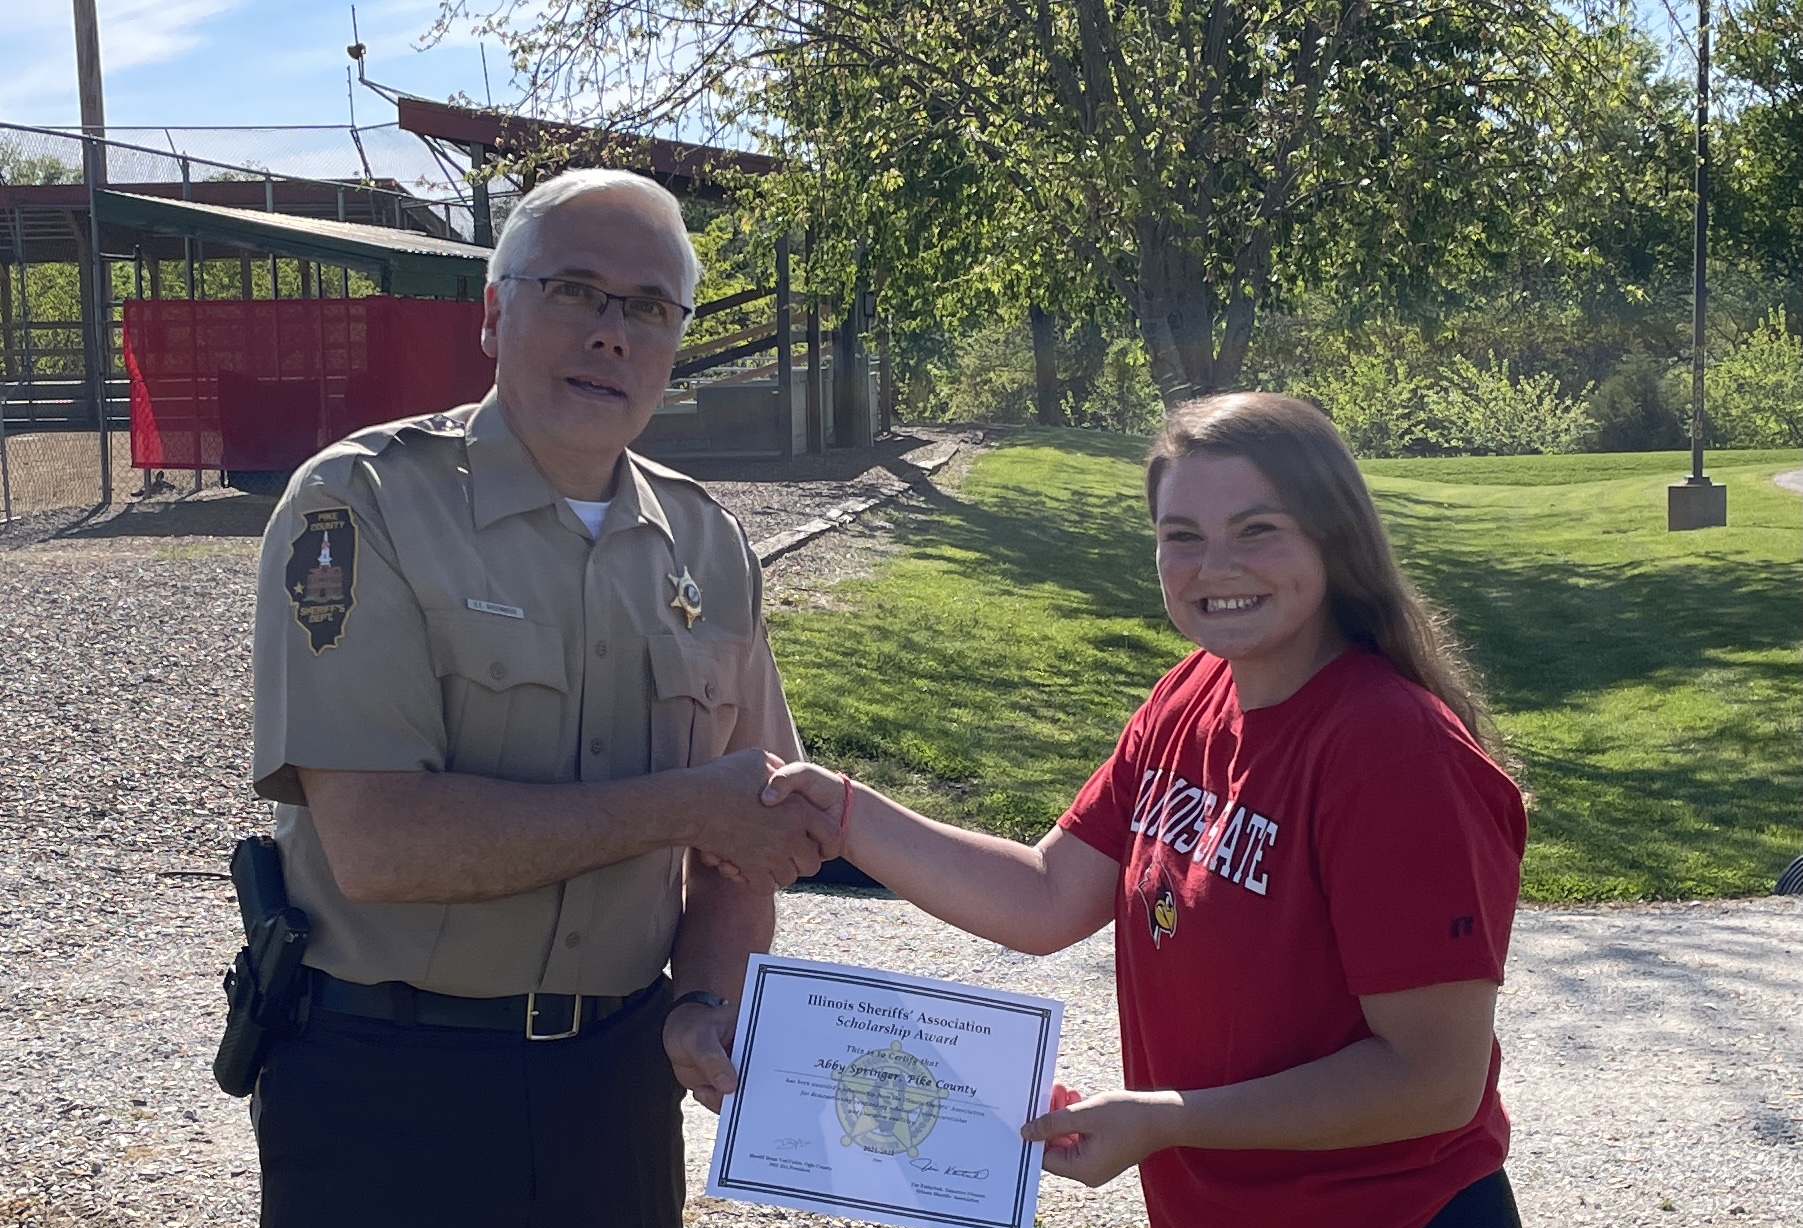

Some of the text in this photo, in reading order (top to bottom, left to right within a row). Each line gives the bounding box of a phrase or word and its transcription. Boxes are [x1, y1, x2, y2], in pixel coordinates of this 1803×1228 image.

[808, 994, 854, 1011] Illinois
[917, 1012, 991, 1035] Association
[836, 1015, 959, 1046] Scholarship Award
[847, 1045, 865, 1055] This
[888, 1053, 918, 1066] Certify
[920, 1058, 939, 1067] that
[814, 1058, 846, 1075] Abby
[907, 1073, 932, 1087] Pike
[935, 1079, 978, 1097] County
